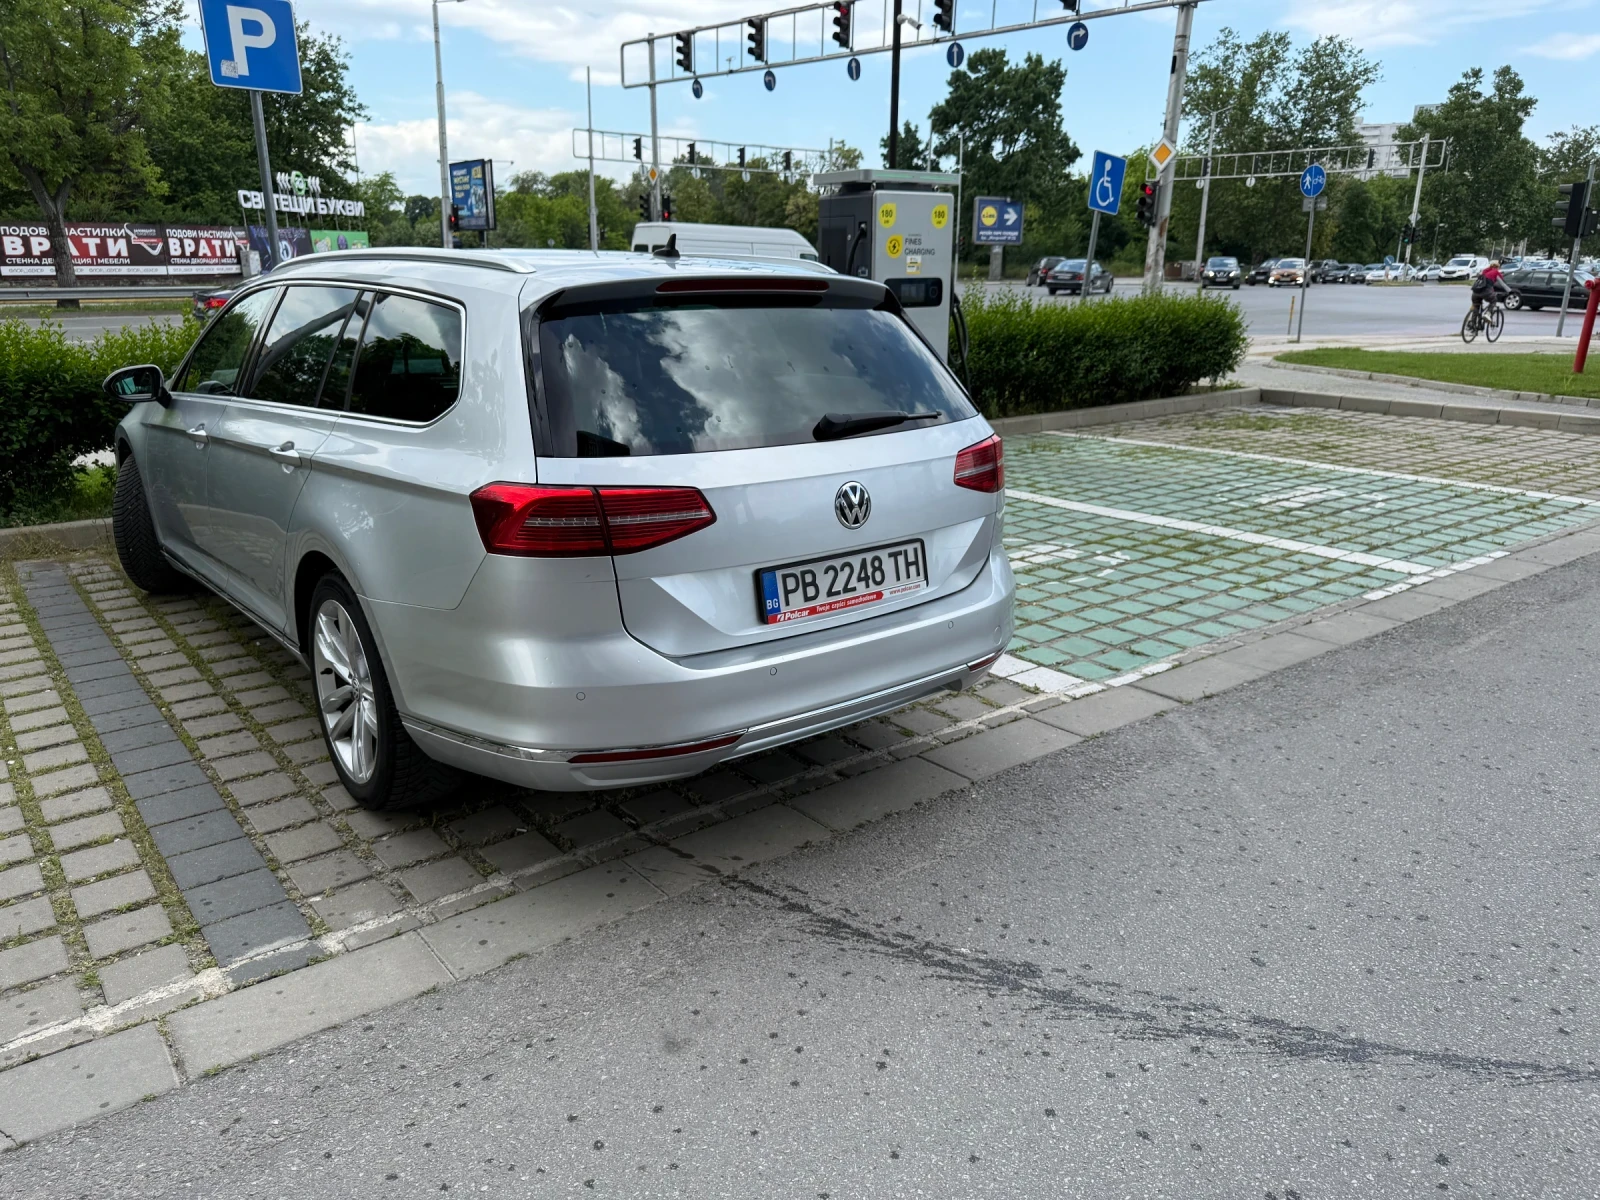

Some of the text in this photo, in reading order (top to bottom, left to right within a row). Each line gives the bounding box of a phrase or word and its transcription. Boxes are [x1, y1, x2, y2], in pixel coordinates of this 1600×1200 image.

[226, 5, 276, 76] P
[238, 190, 365, 217] СВТЕЩИ БУКВИ
[881, 209, 893, 218] 180
[934, 211, 945, 219] 180
[166, 229, 198, 238] ПОДОВИ
[904, 238, 922, 246] FINES
[168, 238, 236, 257] ВРАТИ
[904, 248, 936, 256] CHARGING
[6, 257, 40, 265] СТЕННА
[42, 258, 92, 266] ДЕЦИЯ
[781, 547, 921, 607] PB 2248 TH
[766, 598, 779, 609] BG
[784, 610, 810, 621] Polcar
